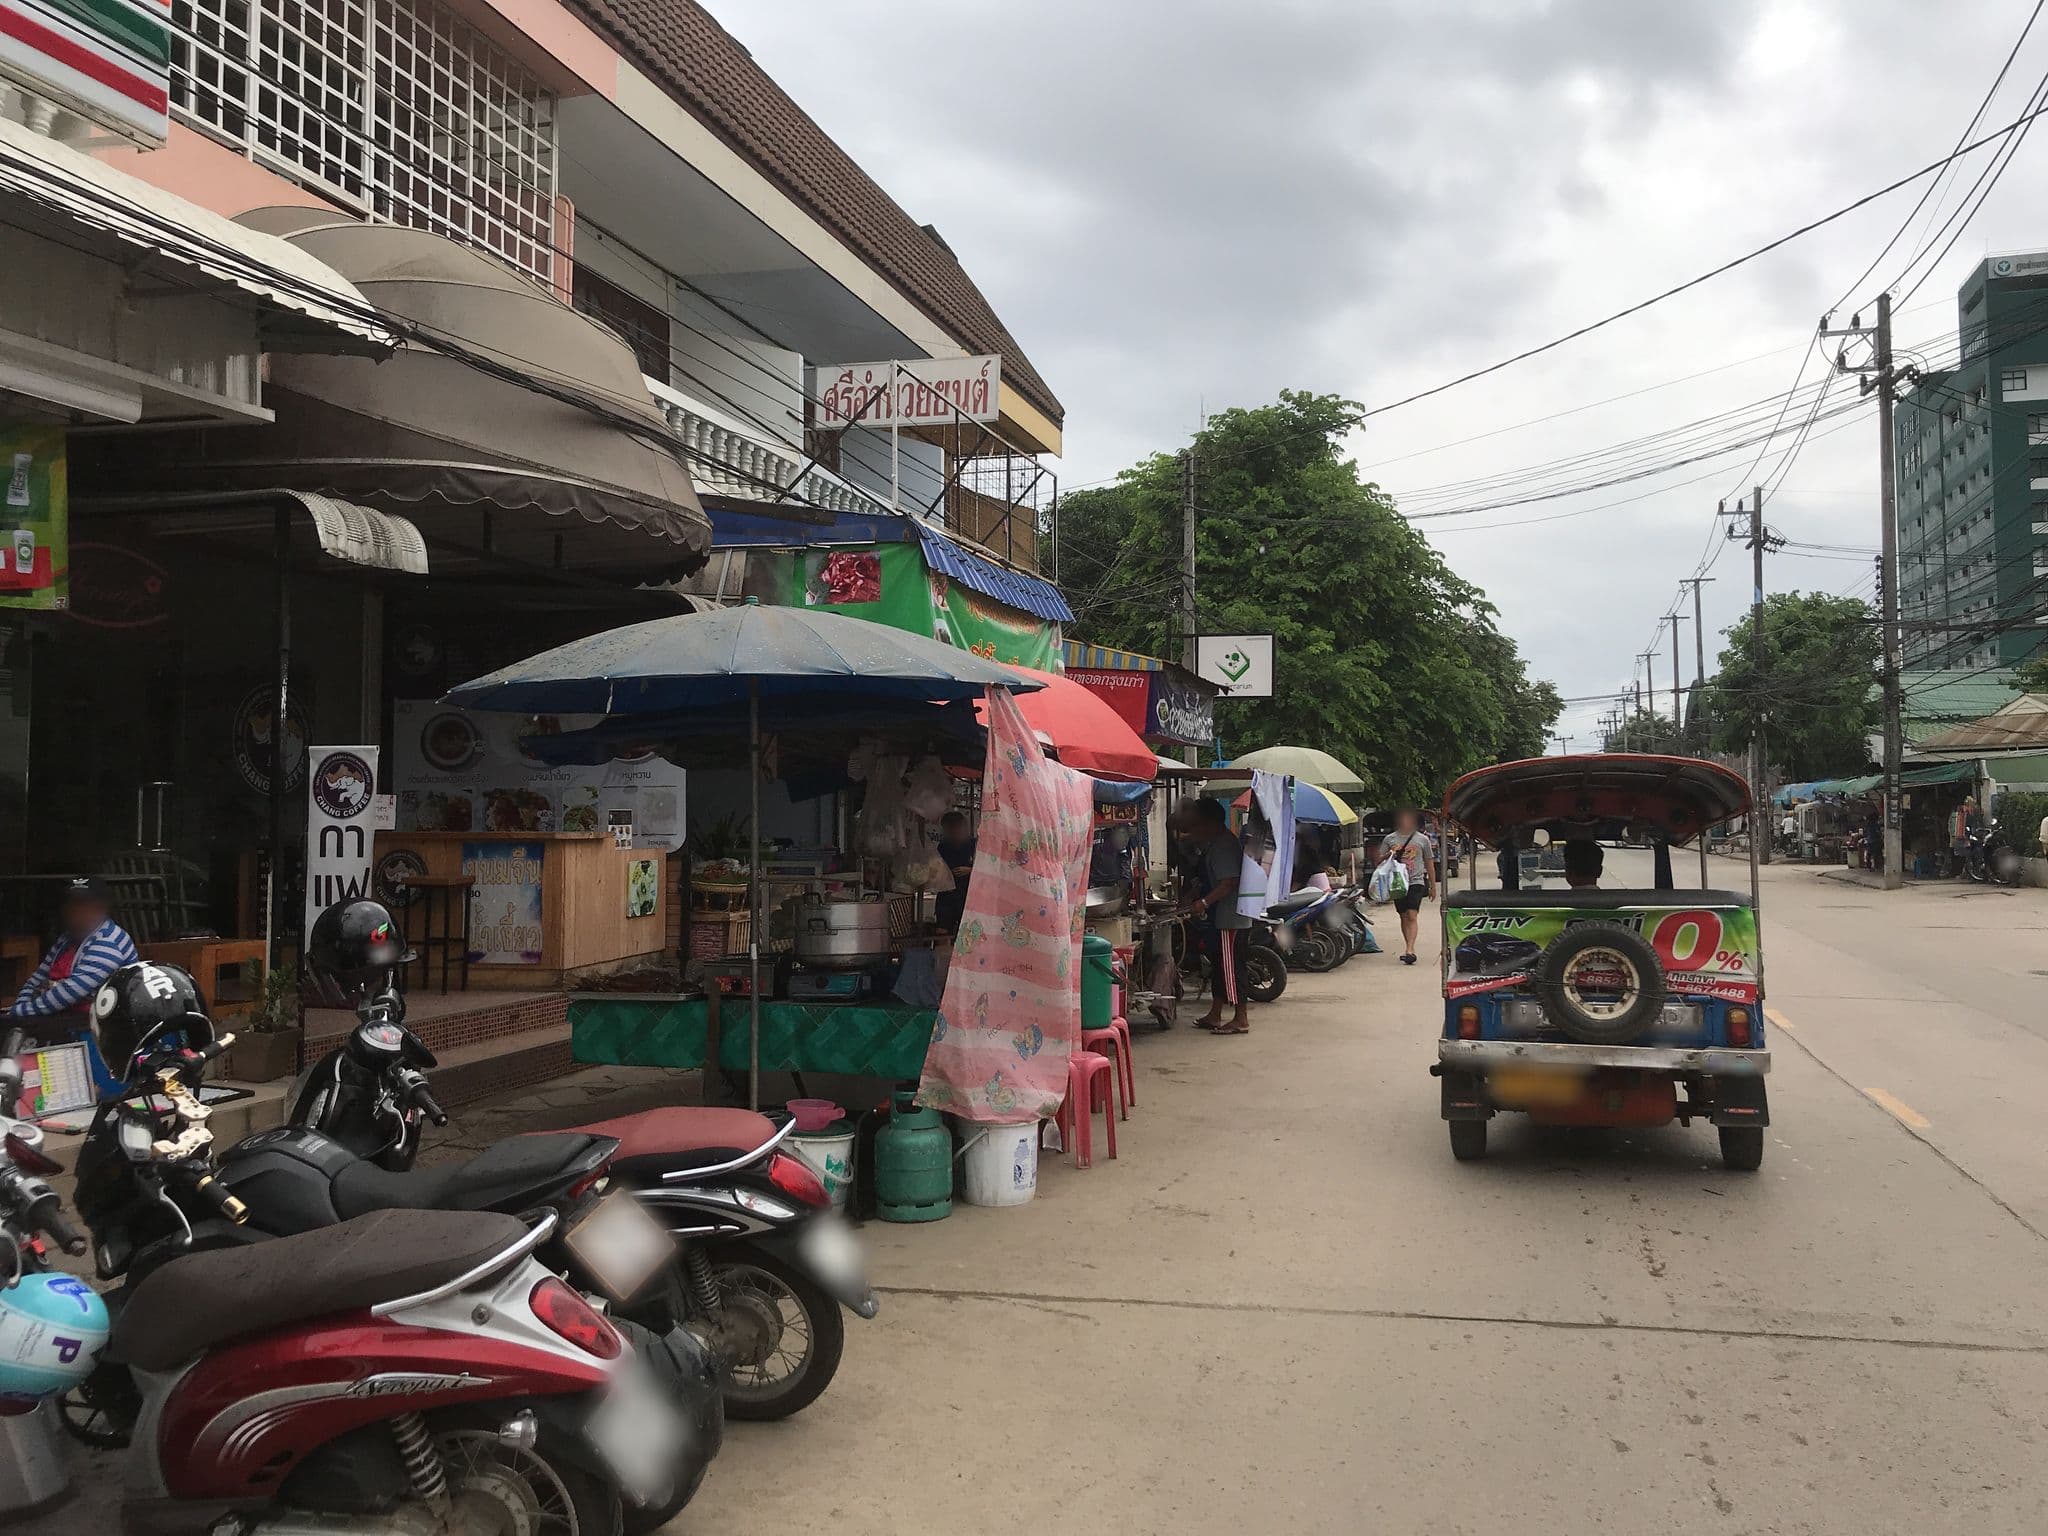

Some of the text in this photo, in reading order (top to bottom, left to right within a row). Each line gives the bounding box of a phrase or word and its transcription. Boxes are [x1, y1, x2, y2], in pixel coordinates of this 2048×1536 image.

[316, 796, 342, 817] CHANG
[343, 793, 371, 817] COFFEE
[1463, 915, 1537, 931] ATIV
